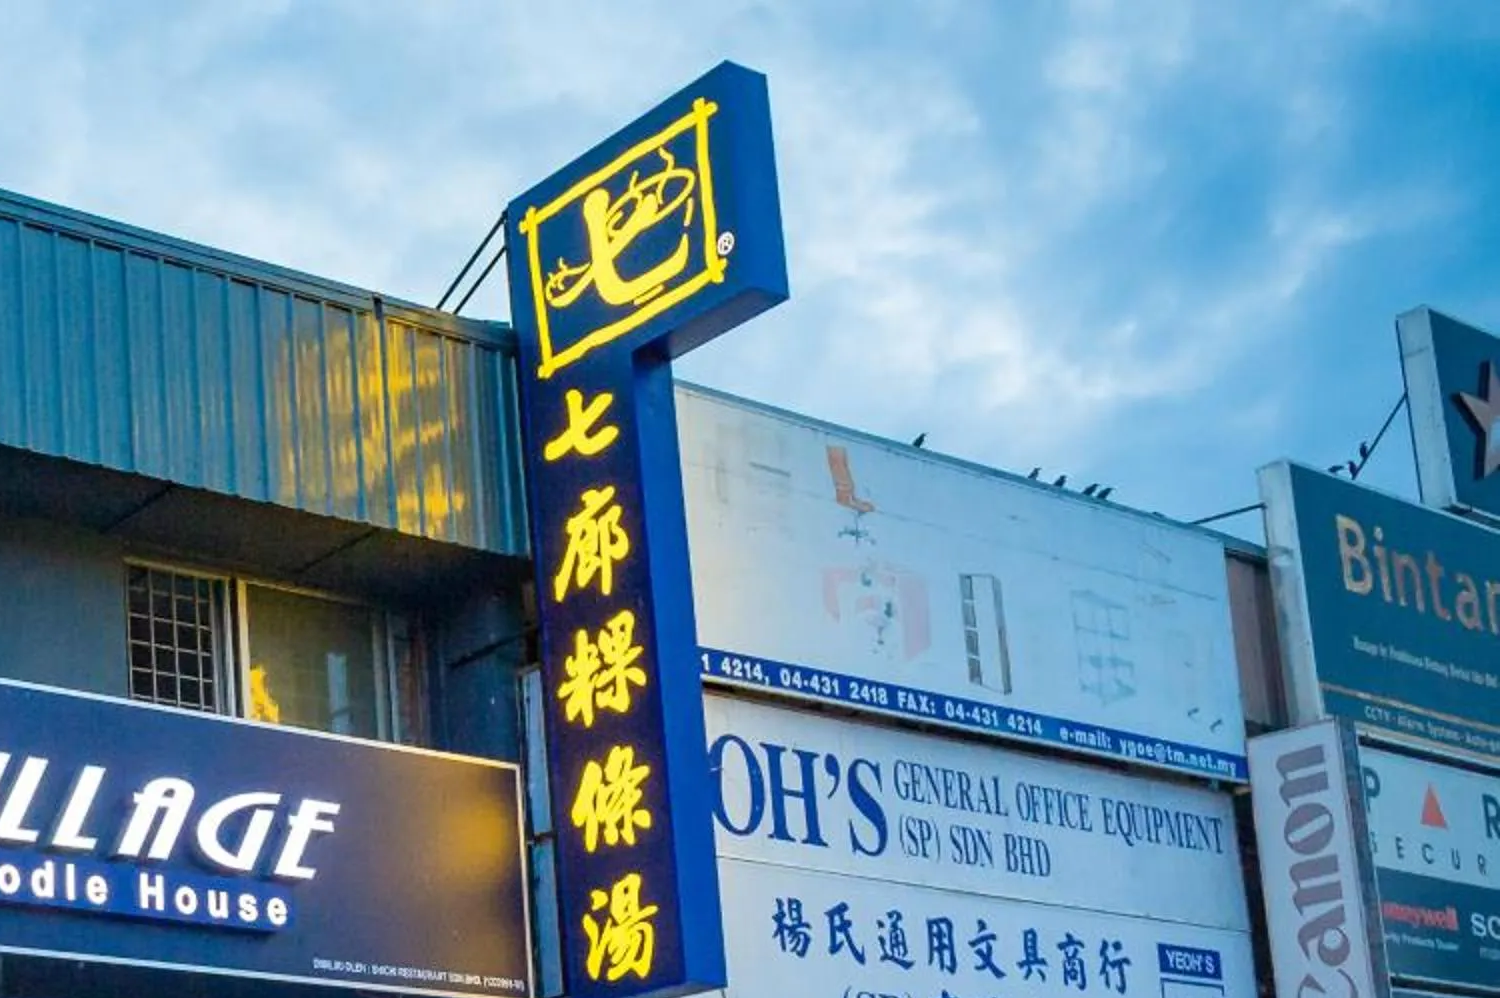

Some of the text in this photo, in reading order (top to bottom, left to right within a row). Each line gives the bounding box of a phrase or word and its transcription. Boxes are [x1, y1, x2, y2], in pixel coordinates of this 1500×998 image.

[543, 388, 659, 982] 七廊粿條湯
[721, 657, 770, 686] 4214,
[780, 670, 840, 696] 04-431
[850, 683, 889, 705] 2418
[897, 691, 936, 715] FAX:
[945, 699, 999, 727] 04-431
[1007, 712, 1043, 736] 4214
[1060, 725, 1112, 750] e-mail:
[893, 759, 1010, 817] GENERAL
[1016, 782, 1093, 833] OFFICE
[1100, 797, 1224, 855] EQUIPMENT
[899, 816, 1052, 878] (SP) SDN BHD
[140, 874, 290, 927] House
[772, 897, 1132, 996] 楊氏通用文具商行
[1165, 949, 1215, 974] YEOH'S
